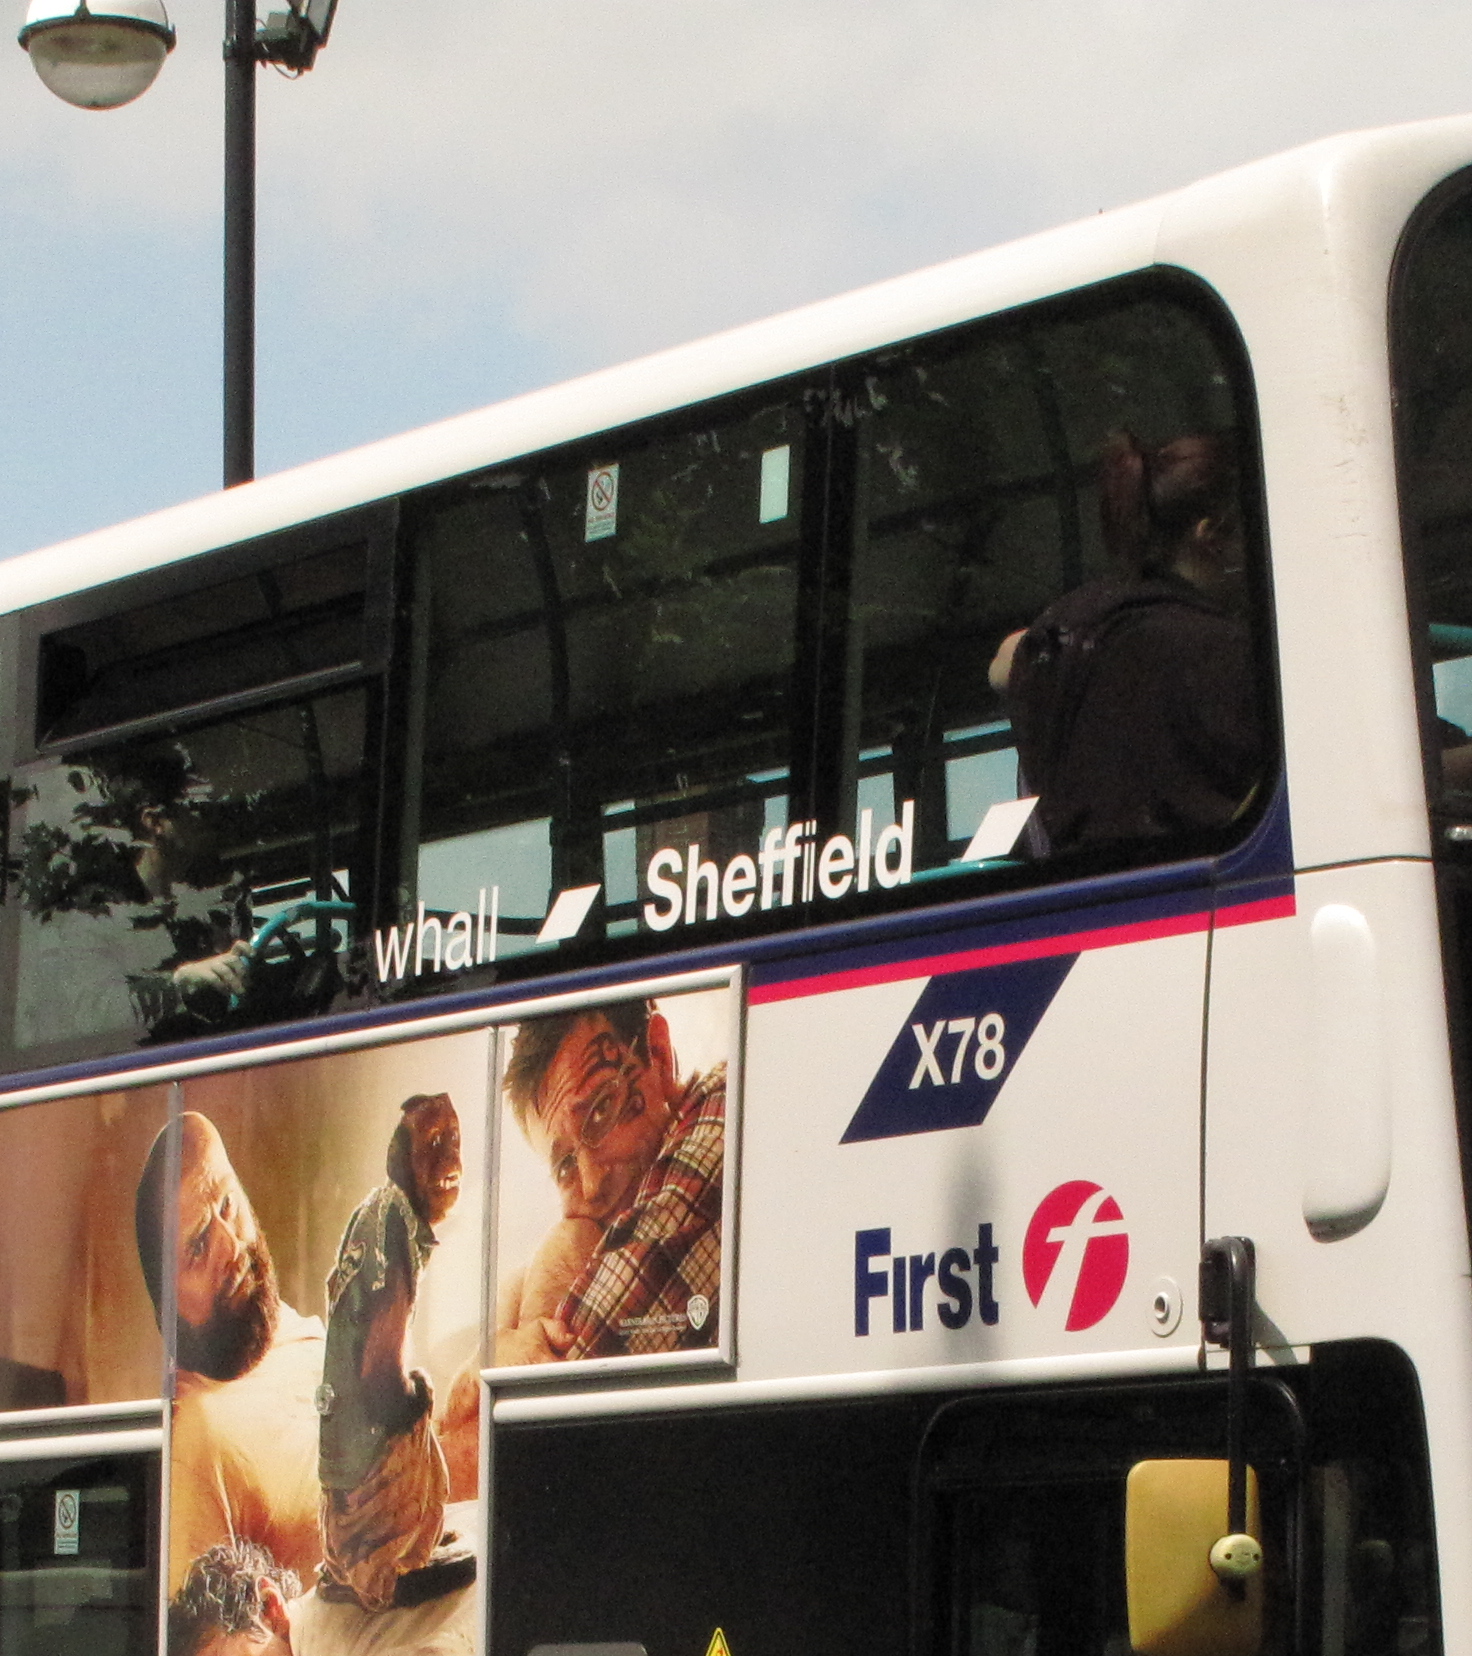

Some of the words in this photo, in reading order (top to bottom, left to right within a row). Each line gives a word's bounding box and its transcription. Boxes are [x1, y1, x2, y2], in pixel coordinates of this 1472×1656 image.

[644, 801, 915, 932] Sheffield
[374, 886, 500, 984] whall
[908, 1012, 1006, 1090] X78
[854, 1222, 1000, 1338] First
